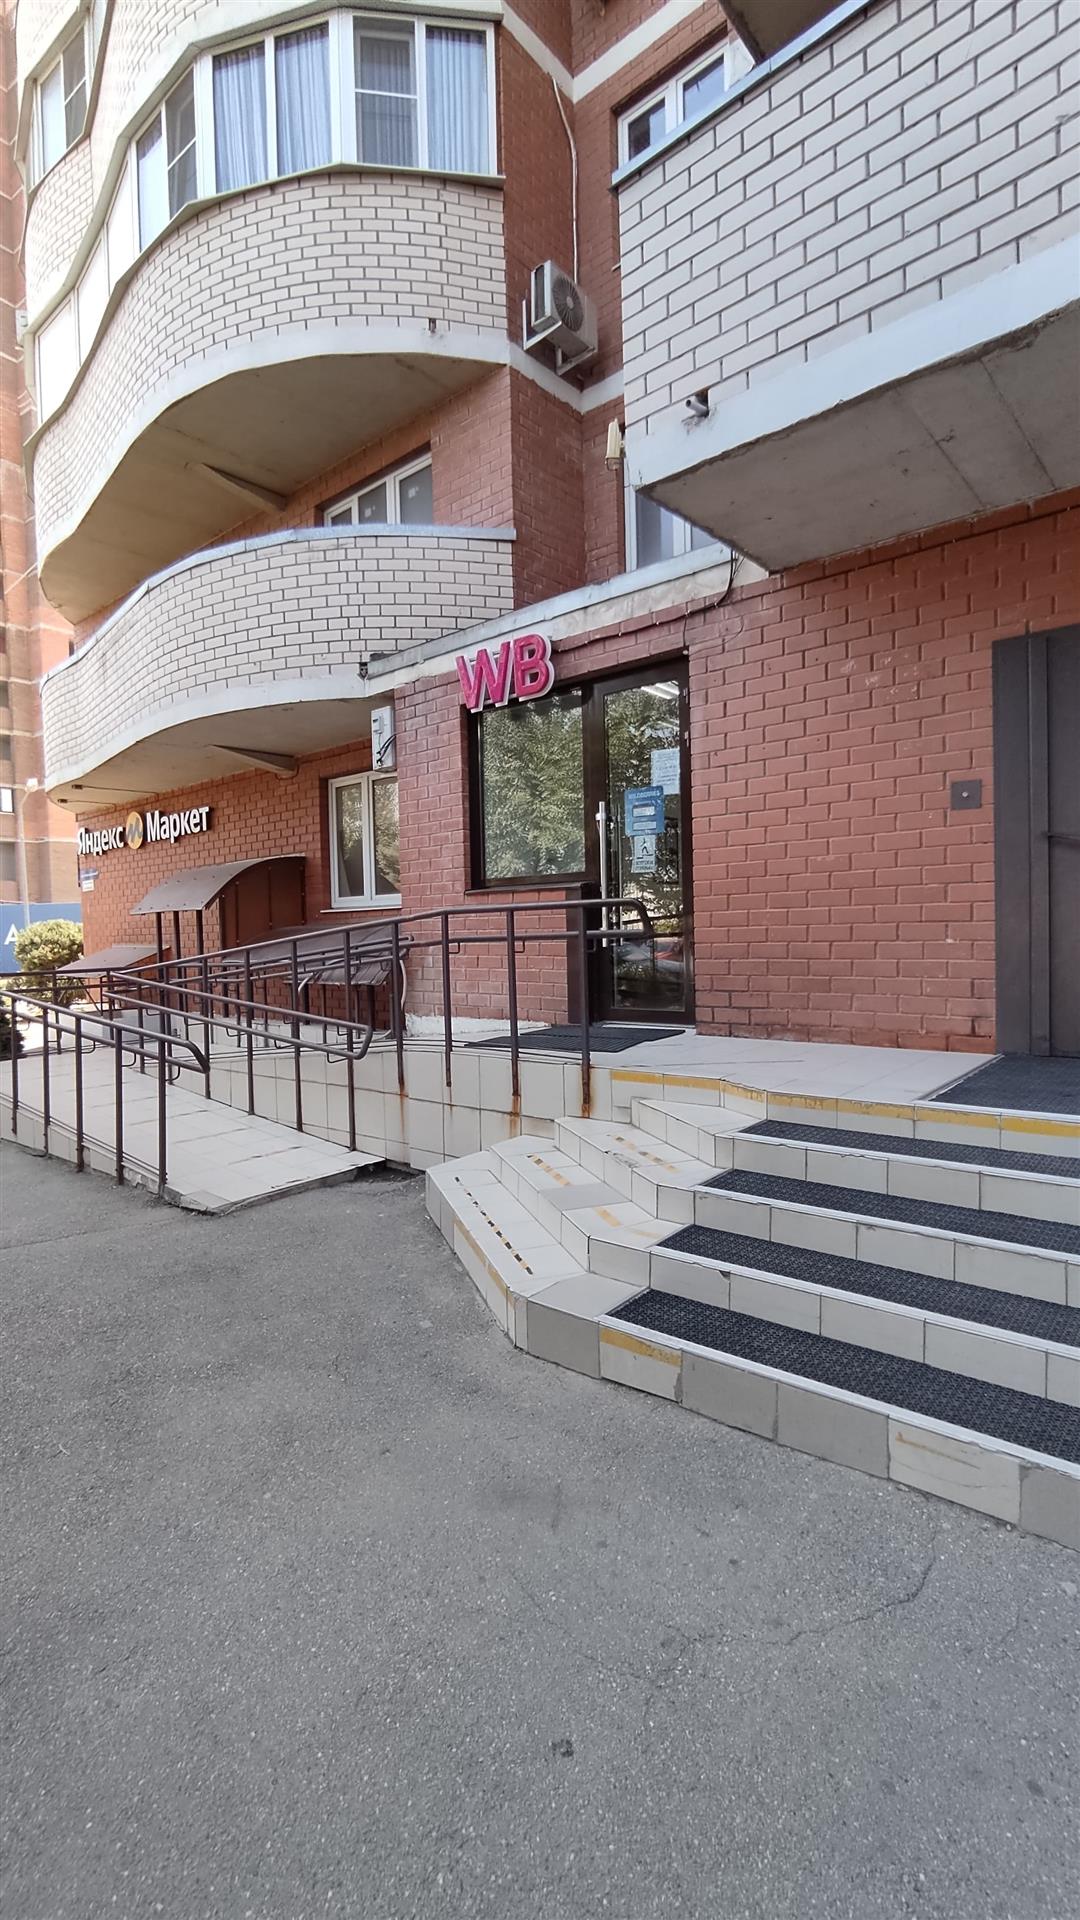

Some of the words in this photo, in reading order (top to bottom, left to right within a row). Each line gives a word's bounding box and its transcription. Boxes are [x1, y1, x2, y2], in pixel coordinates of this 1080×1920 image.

[455, 633, 555, 713] WB
[76, 826, 125, 856] Яндекс
[146, 806, 210, 843] Маркет
